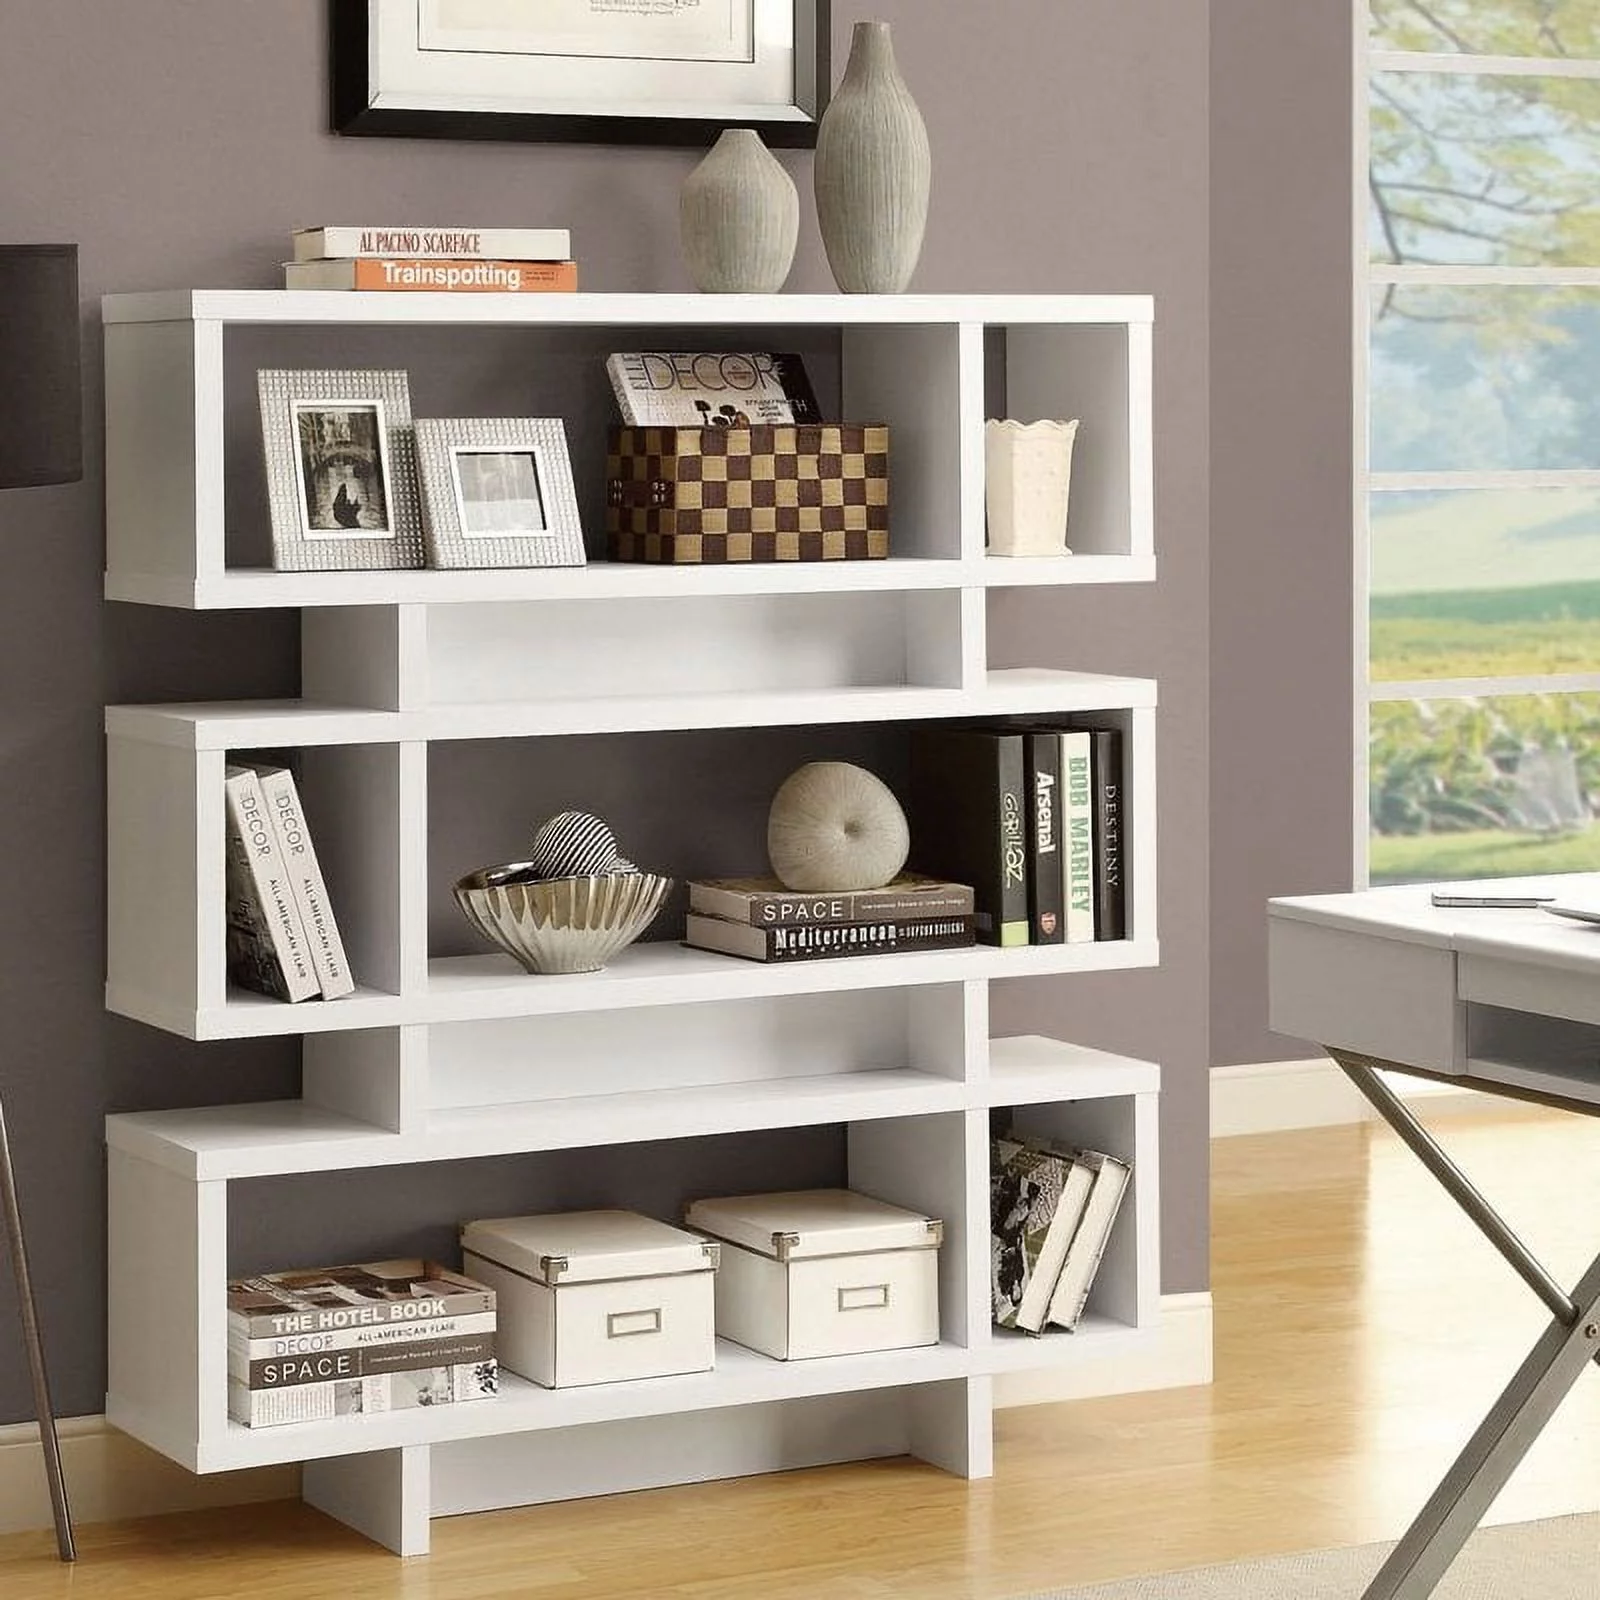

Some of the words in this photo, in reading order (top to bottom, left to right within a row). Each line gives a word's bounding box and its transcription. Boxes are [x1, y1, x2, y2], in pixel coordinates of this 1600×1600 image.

[359, 232, 374, 253] AL
[376, 233, 420, 253] PACINO
[423, 233, 481, 254] SCARFACE
[381, 262, 521, 291] Trainspotting
[641, 353, 781, 390] DECOR
[1068, 756, 1089, 807] BOB
[241, 796, 272, 858] DECOR
[276, 796, 305, 856] DECOR
[1037, 771, 1057, 854] Arsenal
[1105, 785, 1121, 887] DESTINY
[1071, 817, 1090, 913] MARLEY
[763, 901, 844, 921] SPACE
[775, 924, 897, 950] Mediterranean
[271, 1314, 312, 1334] THE
[316, 1306, 384, 1329] HOTEL
[390, 1299, 447, 1319] BOOK
[275, 1335, 334, 1355] DECOR
[263, 1355, 350, 1384] SPACE
